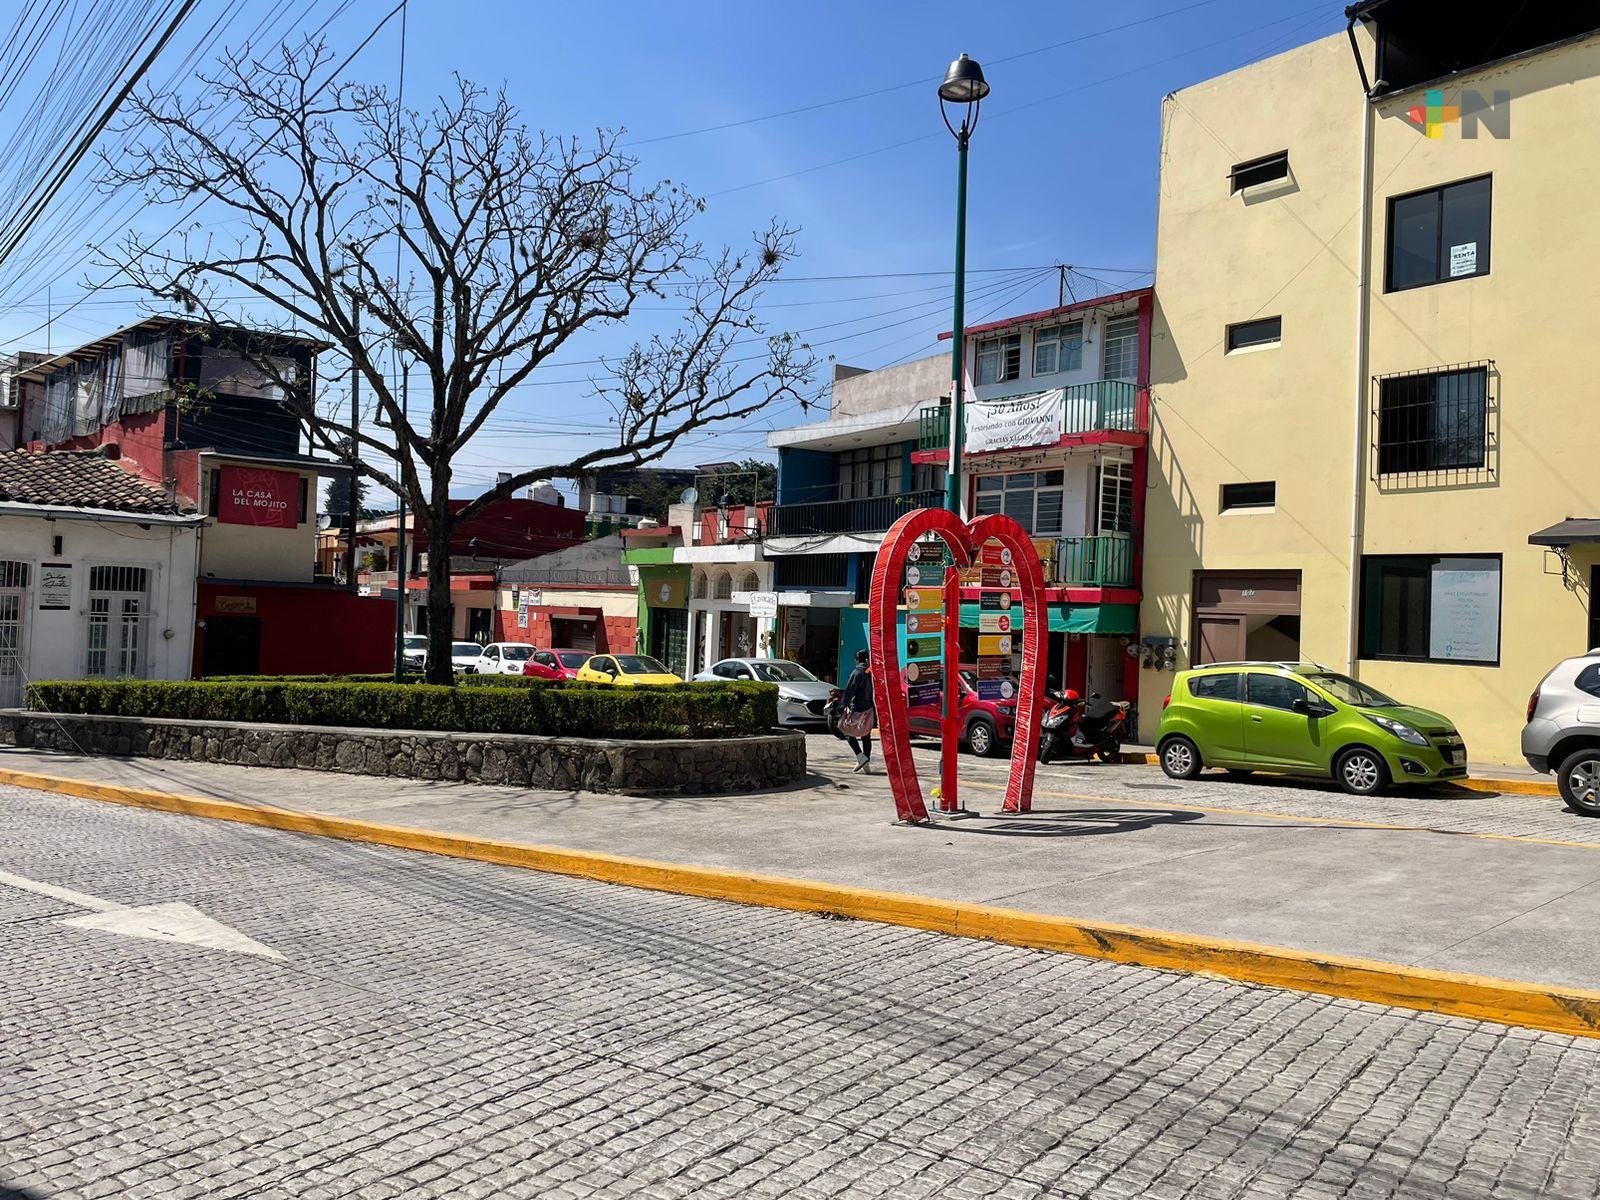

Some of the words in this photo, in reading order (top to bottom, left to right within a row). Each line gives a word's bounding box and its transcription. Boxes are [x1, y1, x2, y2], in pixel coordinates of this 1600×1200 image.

[1453, 250, 1475, 259] RENTA
[1007, 401, 1040, 413] Años!
[1004, 420, 1017, 429] con
[1017, 415, 1054, 426] GIOVANNI
[984, 437, 1009, 446] GRACIAS
[232, 488, 244, 497] LA
[246, 490, 272, 499] CASA
[234, 497, 250, 506] DEL
[253, 499, 288, 509] MOJITO
